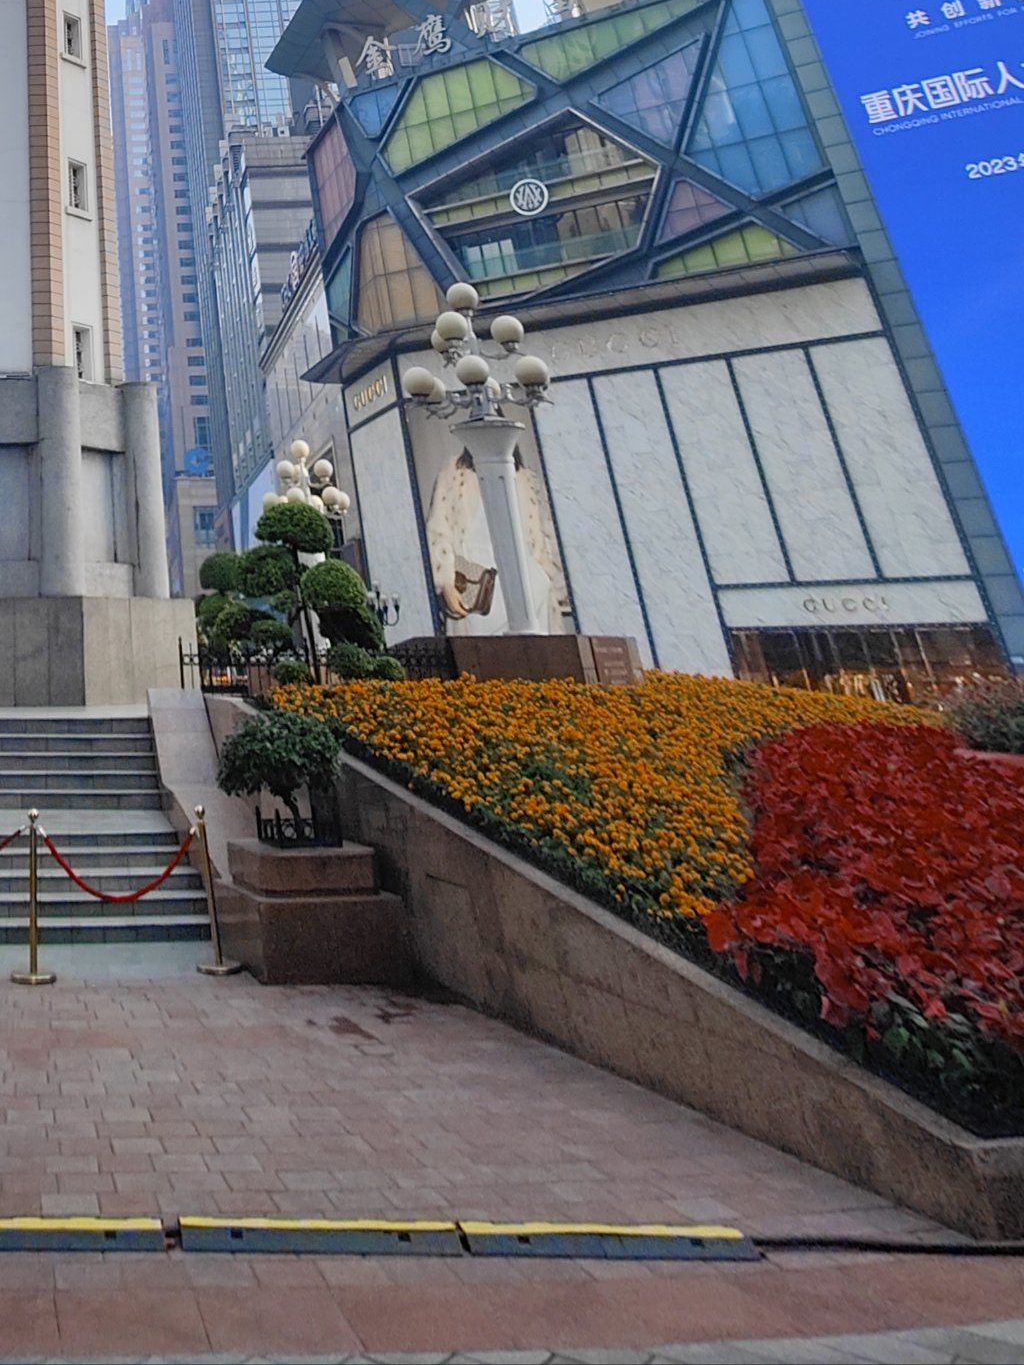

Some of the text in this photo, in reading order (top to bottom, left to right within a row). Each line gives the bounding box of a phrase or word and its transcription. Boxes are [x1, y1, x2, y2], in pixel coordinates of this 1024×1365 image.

[860, 61, 1024, 124] 重庆国际人
[872, 96, 1023, 136] CHONGQING INTERNATIONAL
[353, 375, 388, 411] GUCCI
[802, 595, 890, 614] GUCCI
